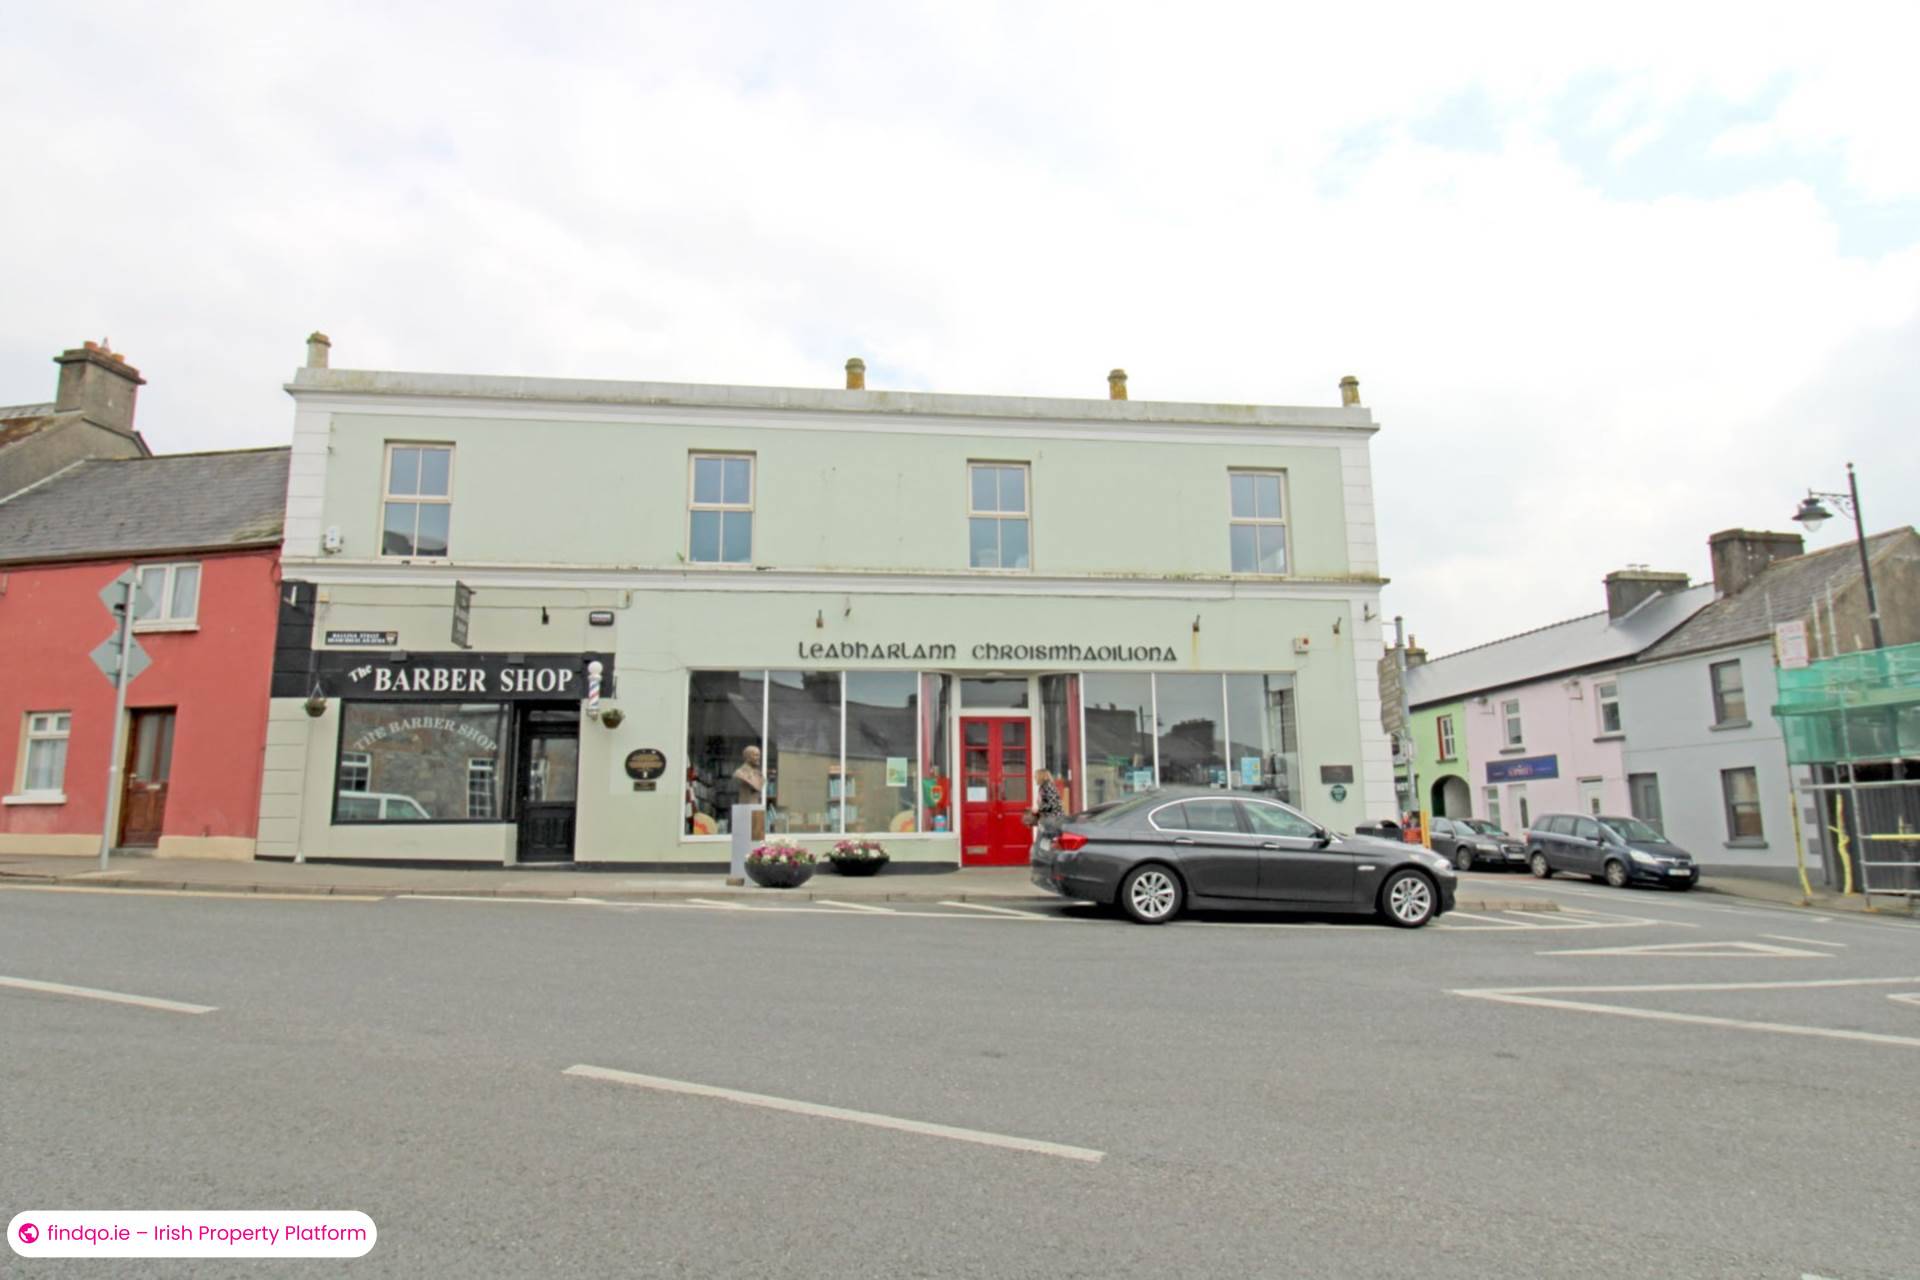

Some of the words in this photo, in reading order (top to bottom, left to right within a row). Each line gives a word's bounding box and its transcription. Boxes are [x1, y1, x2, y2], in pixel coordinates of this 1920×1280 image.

[348, 664, 372, 683] The
[373, 667, 487, 692] BARBER
[499, 668, 573, 692] SHOP
[353, 726, 388, 751] THE
[389, 716, 457, 734] BARBER
[457, 723, 498, 752] SHOP
